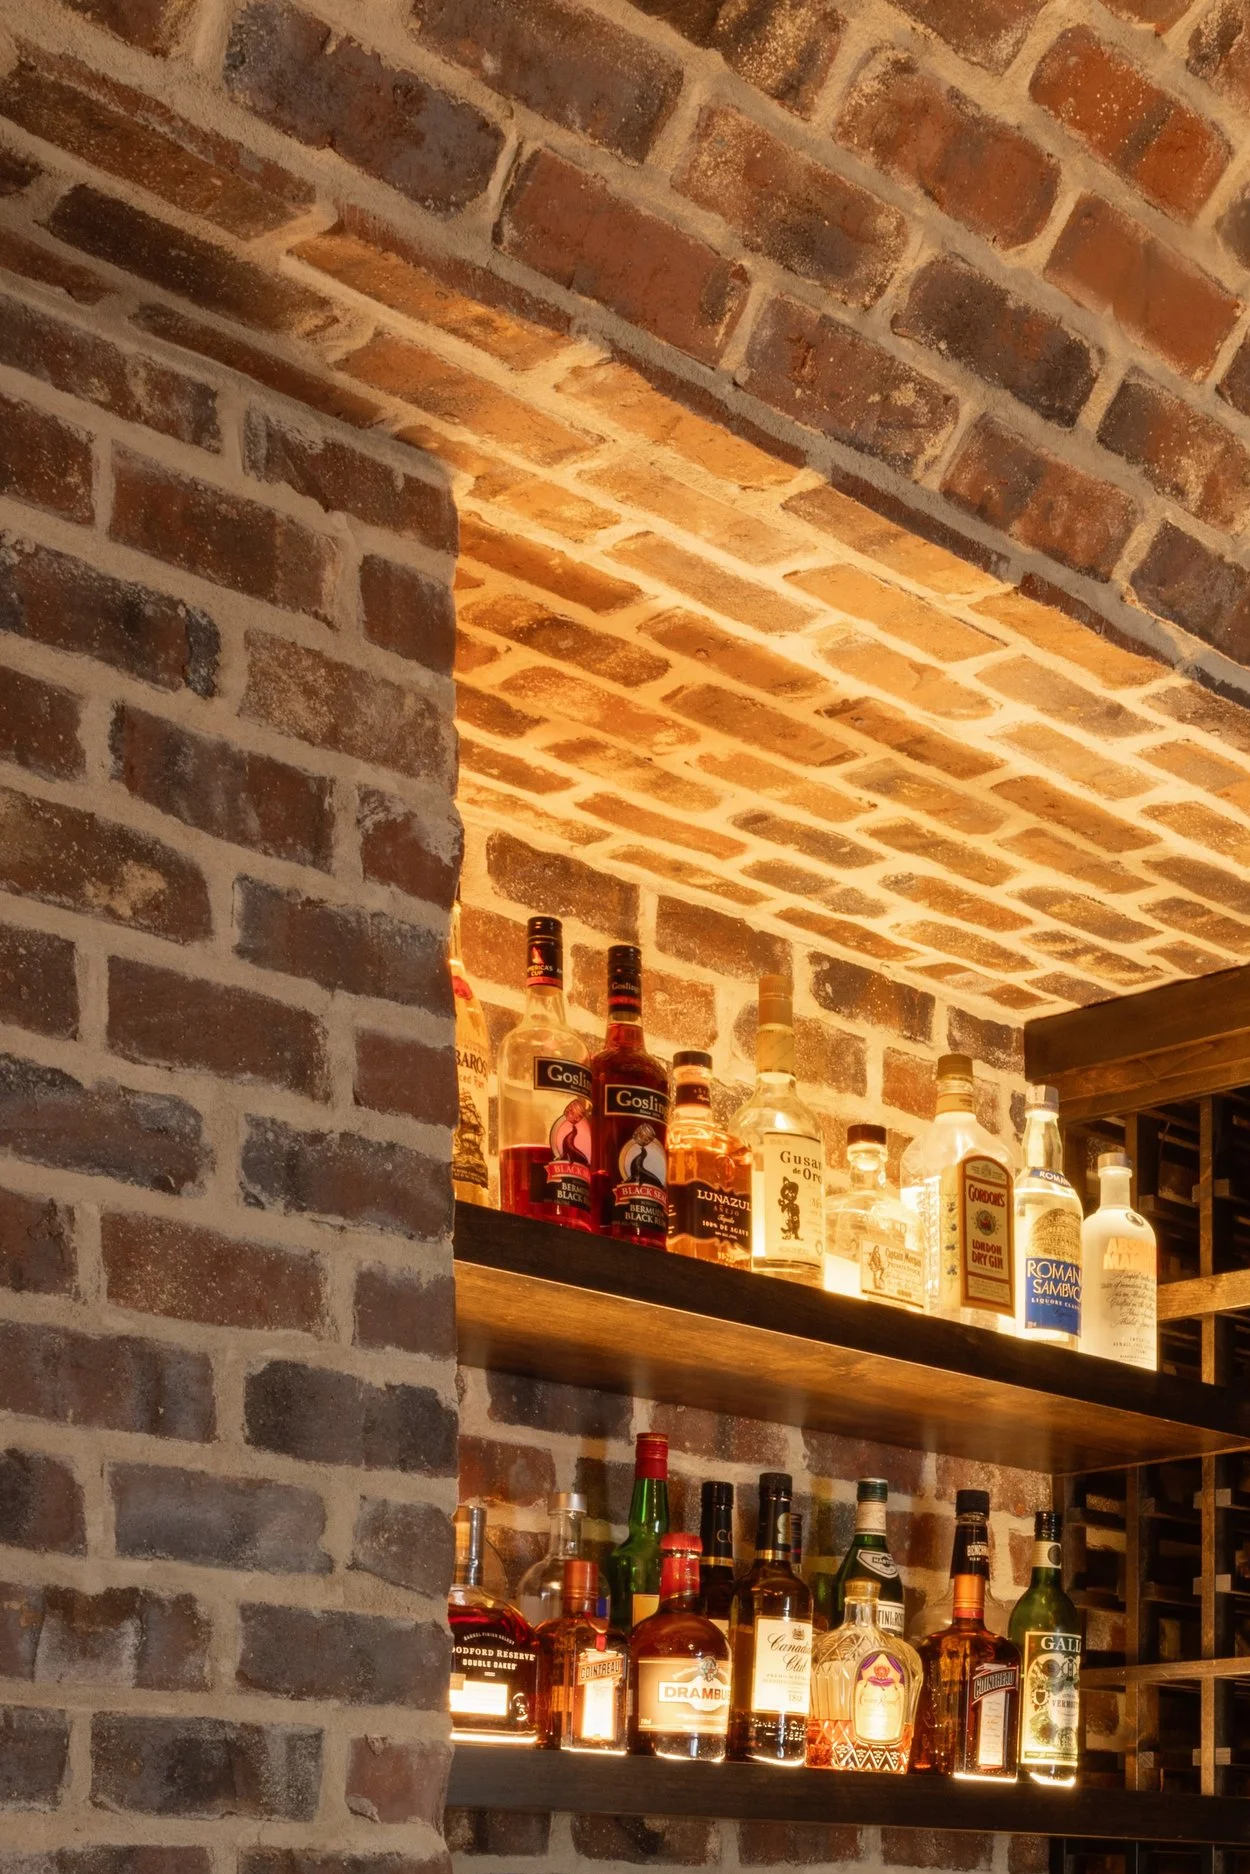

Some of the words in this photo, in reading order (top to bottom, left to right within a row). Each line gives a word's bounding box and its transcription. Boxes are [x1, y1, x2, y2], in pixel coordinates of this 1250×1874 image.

[547, 1064, 592, 1090] Goslin
[616, 1090, 668, 1114] Goslin
[1039, 1170, 1071, 1188] ROMAN
[622, 1186, 653, 1197] BLACK
[696, 1189, 752, 1212] LUNAZUL
[968, 1183, 1006, 1208] GORDON'S
[625, 1212, 653, 1224] BLACK
[971, 1238, 1003, 1256] LONDON
[971, 1249, 989, 1267] DRY
[988, 1255, 1004, 1270] GIN
[1027, 1260, 1081, 1287] ROMAN
[452, 1646, 494, 1657] ODFORD
[496, 1649, 536, 1661] RESERVE
[462, 1658, 491, 1668] DOUBLE
[493, 1661, 517, 1671] OAKED
[580, 1660, 620, 1679] COINTREAU
[974, 1670, 1016, 1700] COINTREAU
